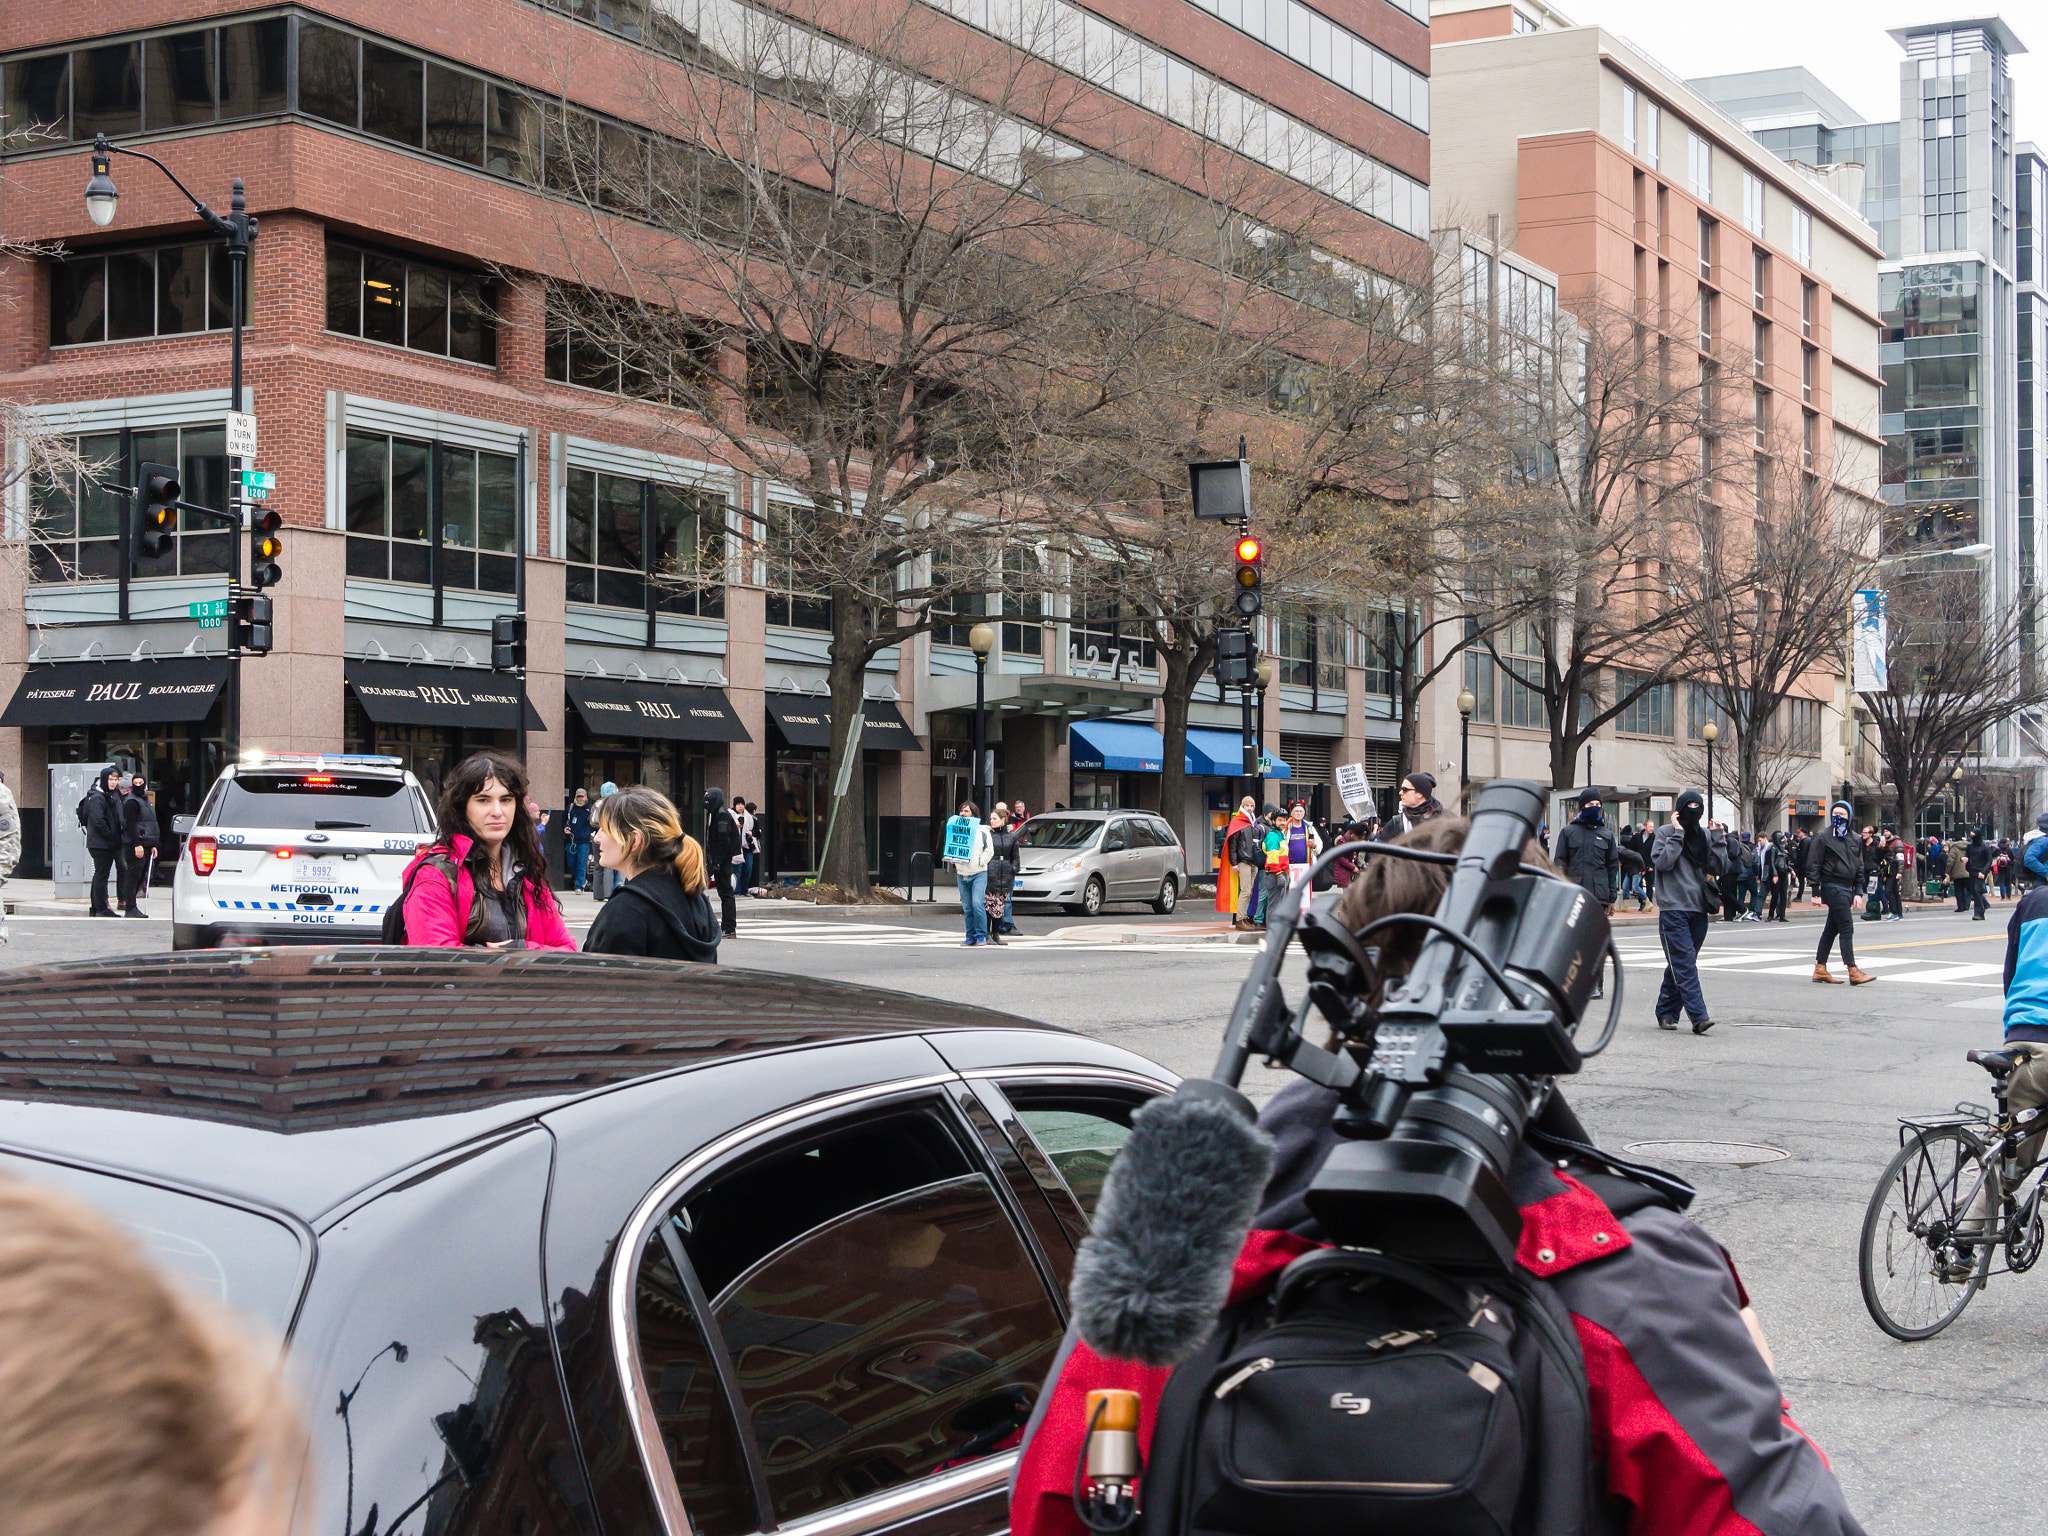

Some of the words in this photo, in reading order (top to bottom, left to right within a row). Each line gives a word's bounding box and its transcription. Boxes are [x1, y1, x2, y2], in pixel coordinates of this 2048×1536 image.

[237, 418, 248, 428] NO
[234, 429, 252, 440] TURN
[230, 442, 239, 450] ON
[242, 442, 254, 452] RED
[250, 472, 256, 486] K
[249, 488, 266, 498] 1200
[197, 604, 208, 616] 13
[200, 618, 220, 628] 1000
[1069, 643, 1140, 682] 1275
[26, 688, 76, 698] PÂTISSERIE
[85, 682, 142, 701] PAUL
[148, 684, 216, 694] BOULANGERIE
[359, 686, 418, 698] BOULANGERIE
[417, 686, 470, 706] PAUL
[472, 694, 498, 702] SALON
[498, 696, 508, 704] DE
[636, 701, 680, 718] PAUL
[944, 748, 956, 760] 1275
[952, 826, 971, 836] HUMAN
[218, 834, 245, 844] SOD
[384, 839, 415, 850] 8709
[952, 834, 968, 845] NEEDS
[948, 846, 958, 856] NOT
[958, 848, 970, 858] WAR
[312, 866, 332, 876] 9992
[270, 884, 359, 894] METROPOLITAN
[1566, 893, 1586, 928] SONY
[293, 914, 334, 924] POLICE
